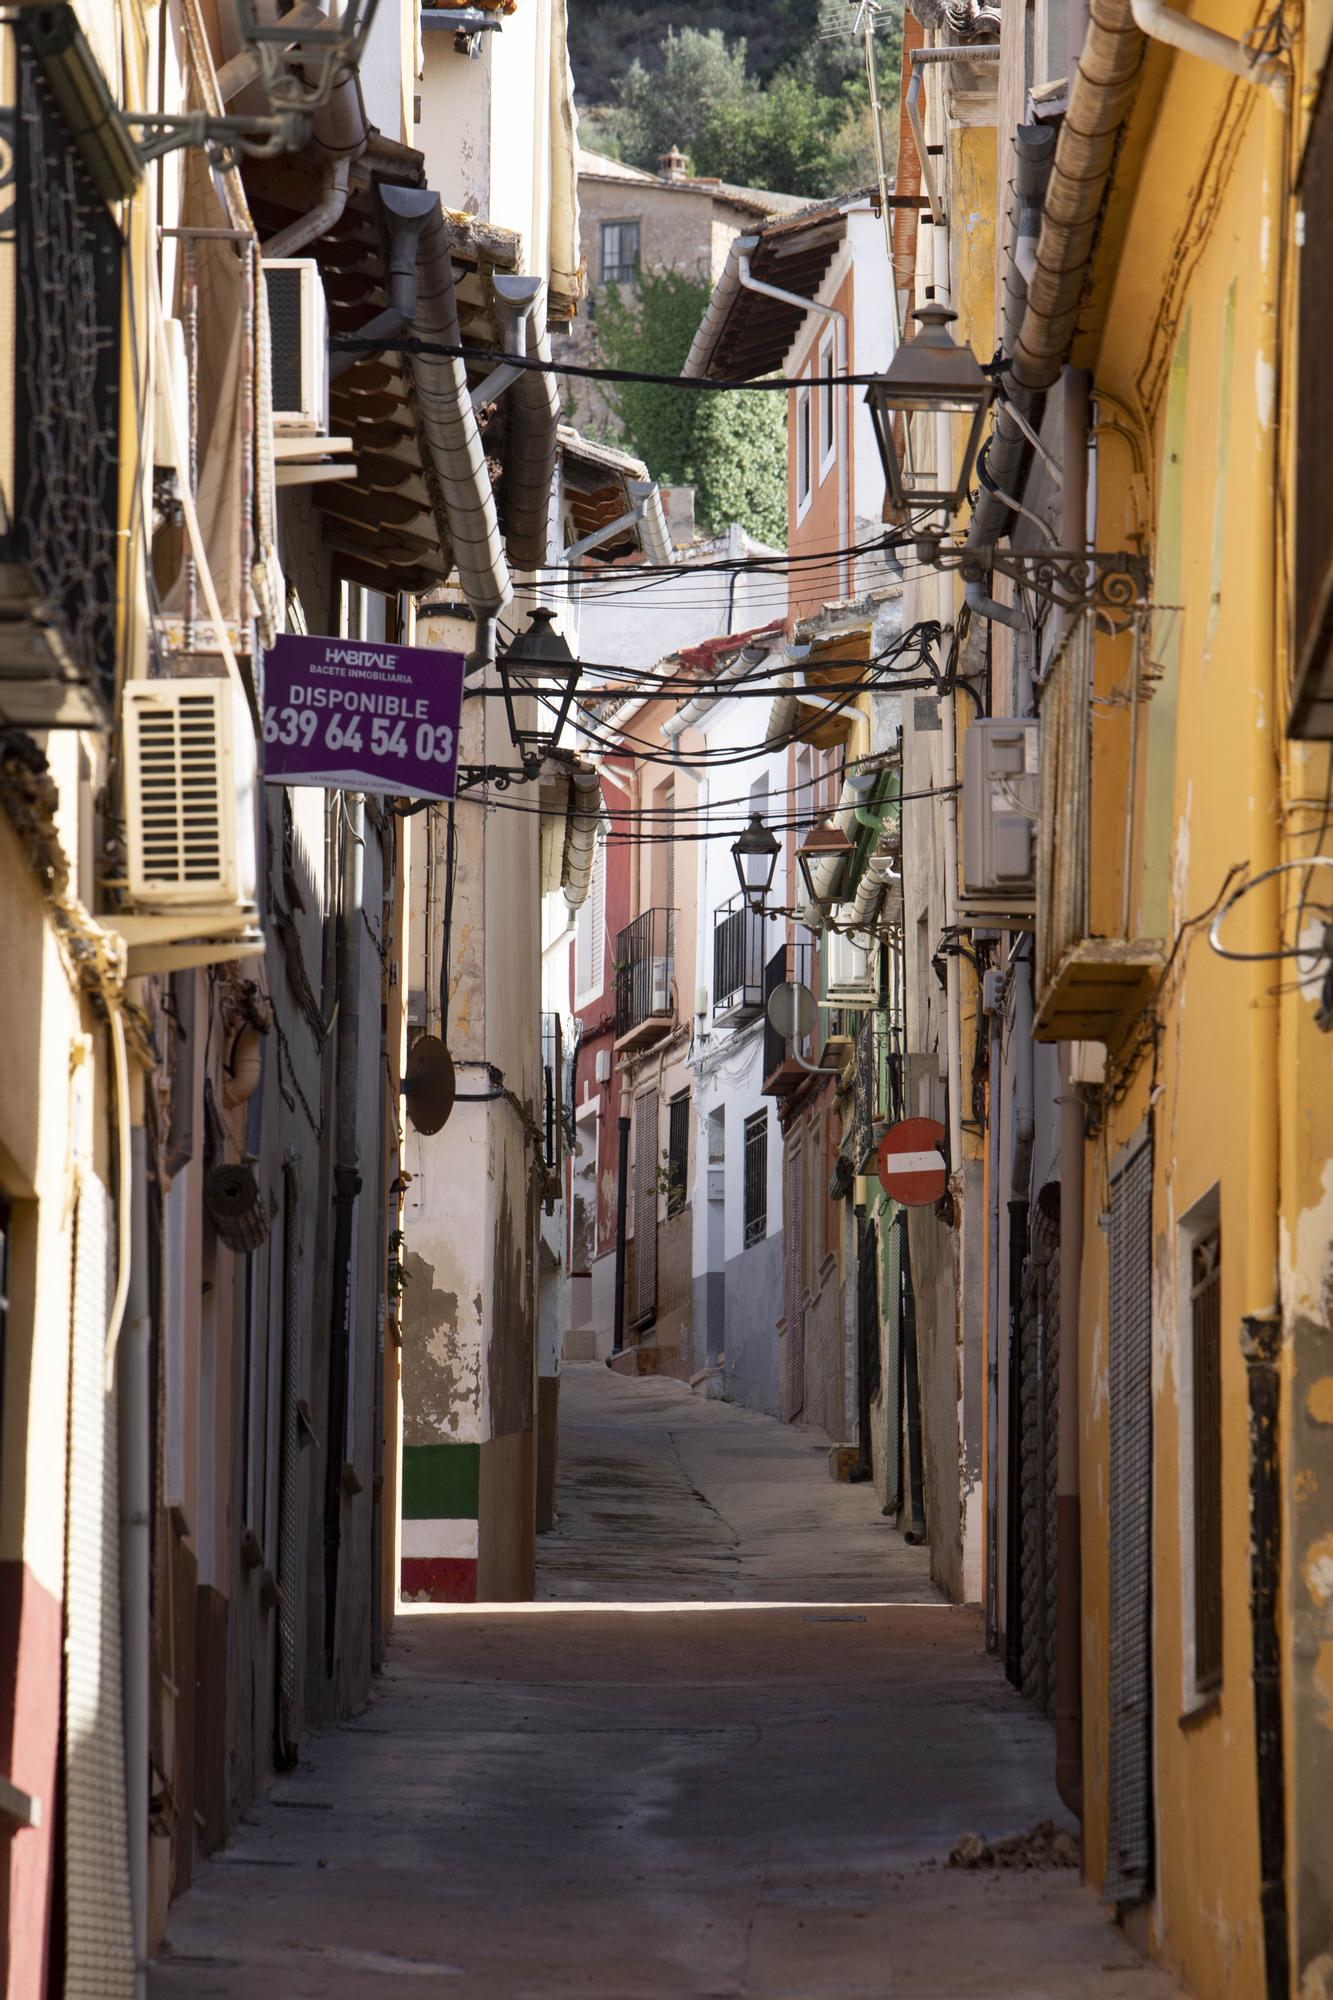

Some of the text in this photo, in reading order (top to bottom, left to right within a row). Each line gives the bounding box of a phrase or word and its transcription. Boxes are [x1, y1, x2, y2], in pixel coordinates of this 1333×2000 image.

[325, 648, 396, 670] HABITALE
[309, 664, 412, 684] BACETE INMOBILIARIA
[290, 685, 430, 719] DISPONIBLE
[263, 706, 453, 763] 639 64 54 03
